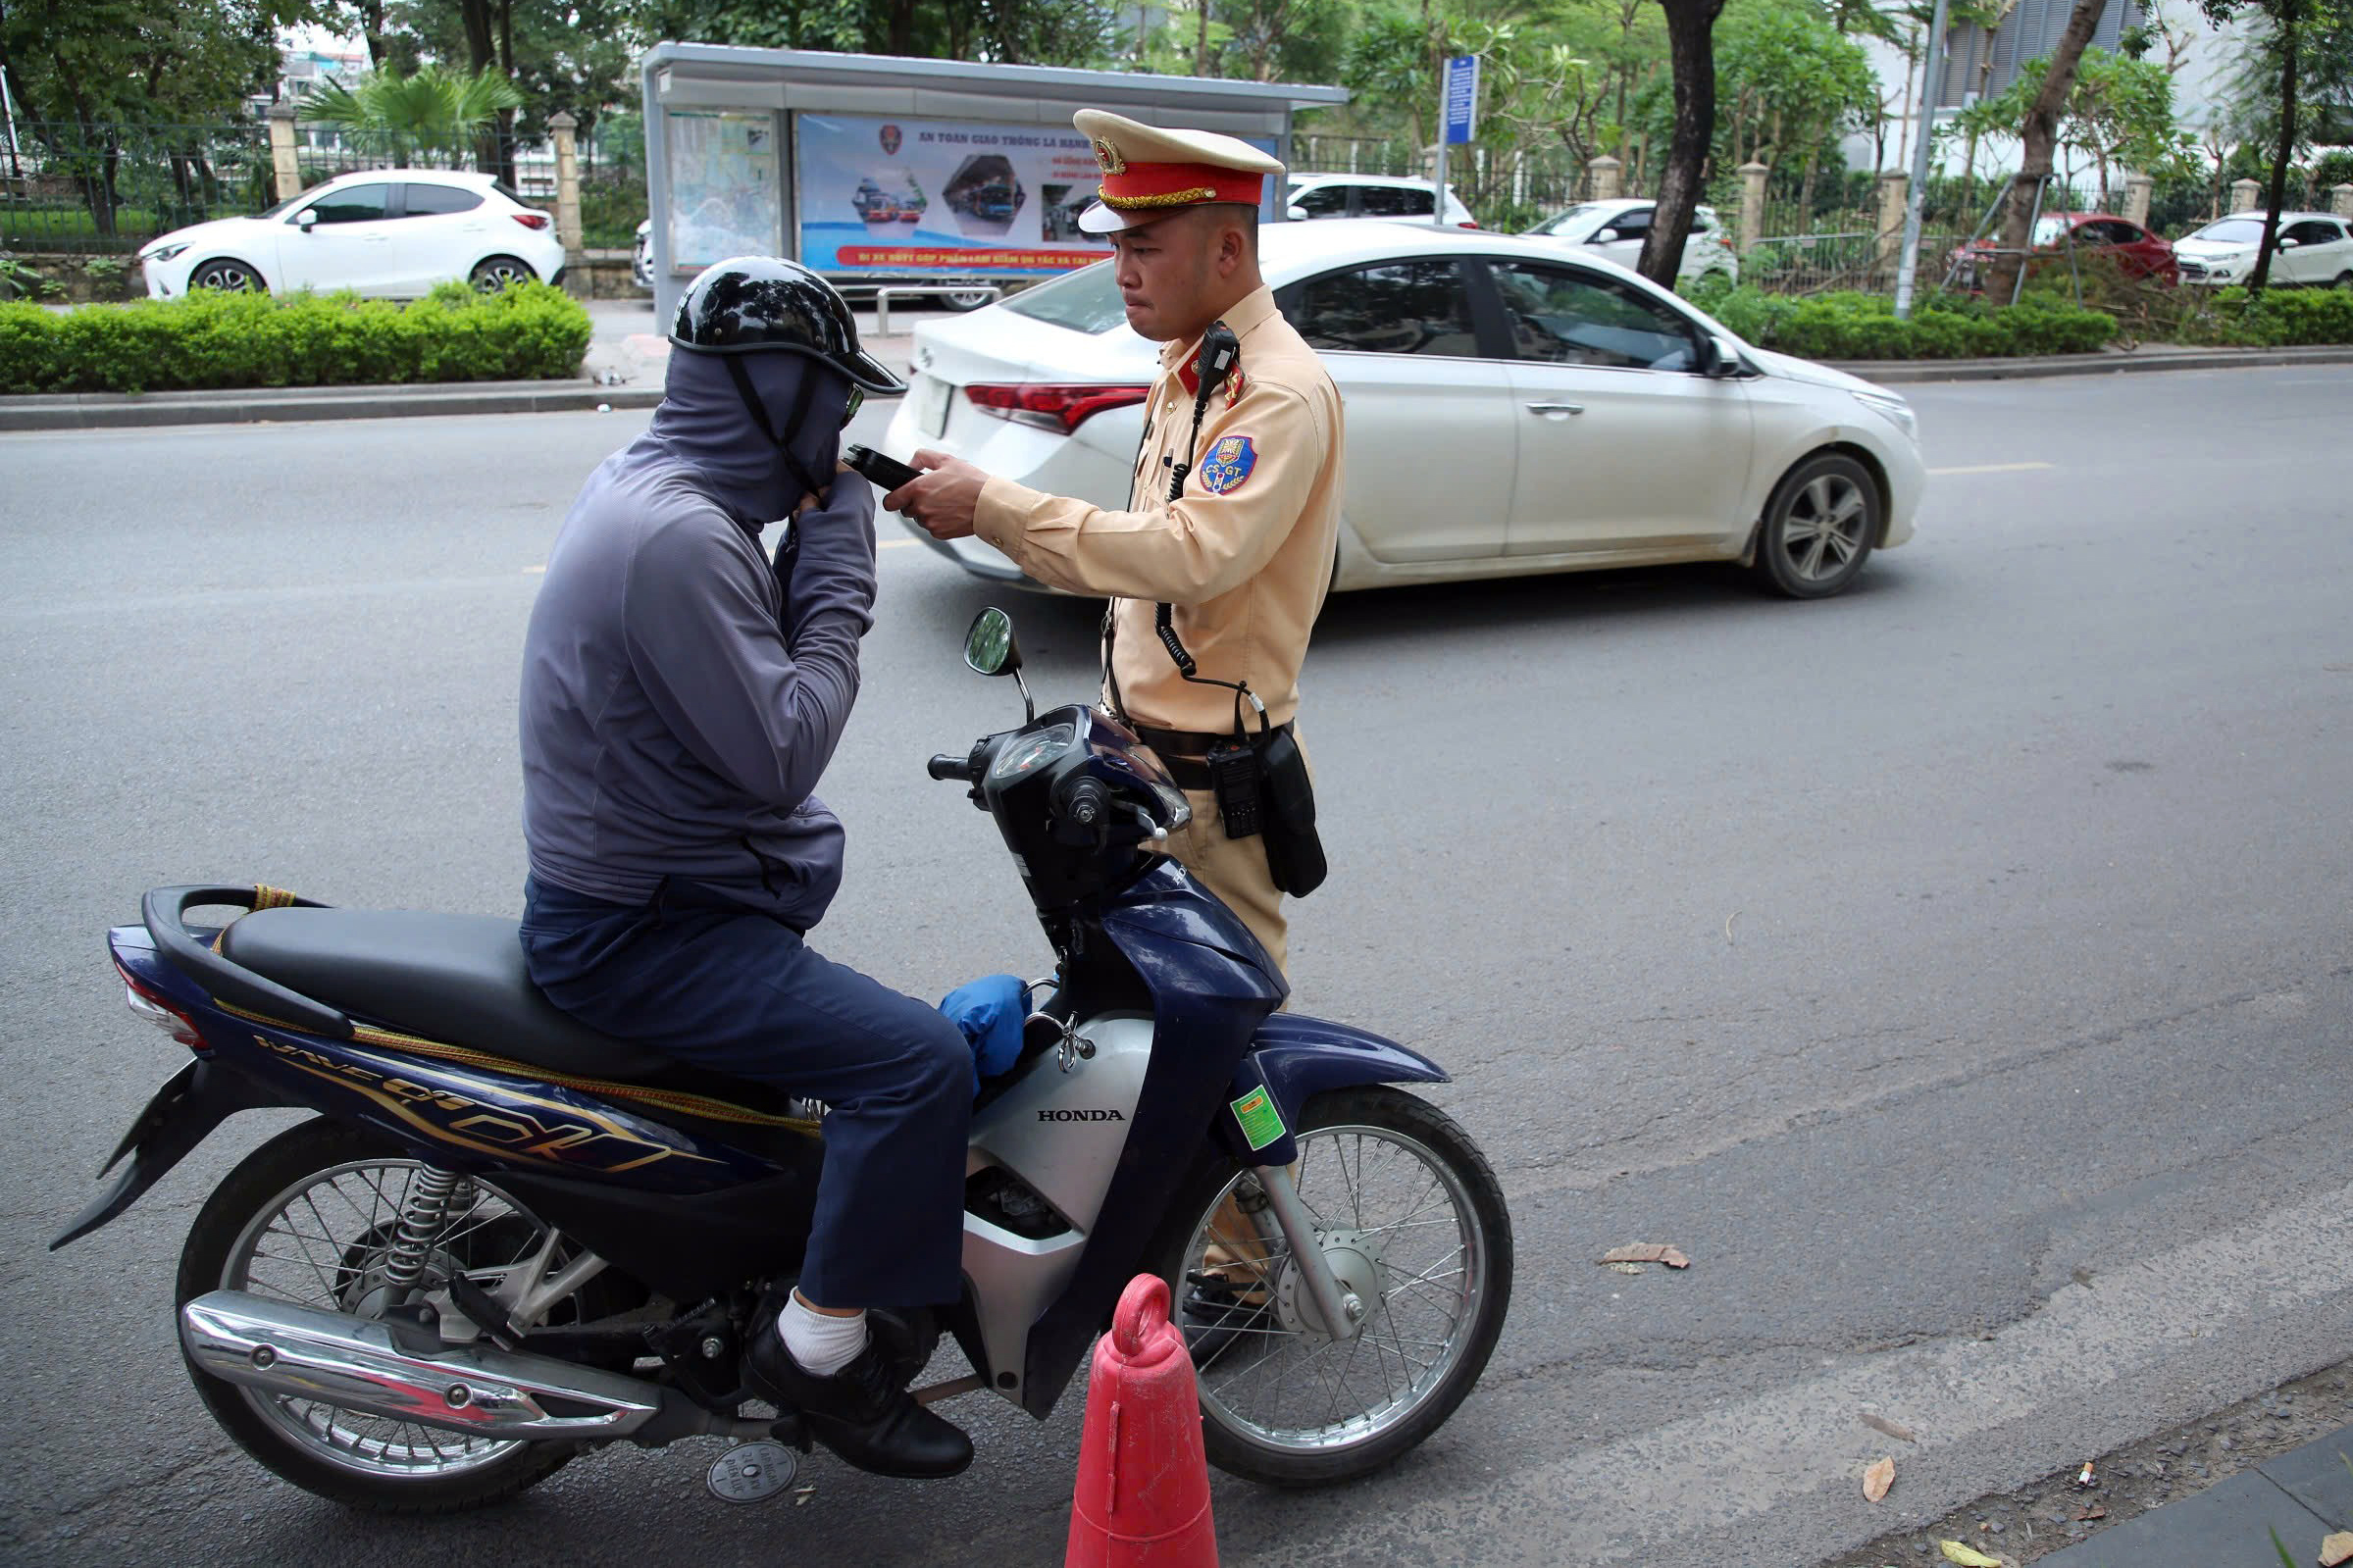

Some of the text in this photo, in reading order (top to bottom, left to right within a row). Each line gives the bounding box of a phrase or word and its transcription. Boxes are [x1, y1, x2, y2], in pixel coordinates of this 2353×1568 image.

[1206, 464, 1242, 477] CS GT
[253, 1035, 384, 1082] WAVE
[1037, 1109, 1126, 1122] HONDA
